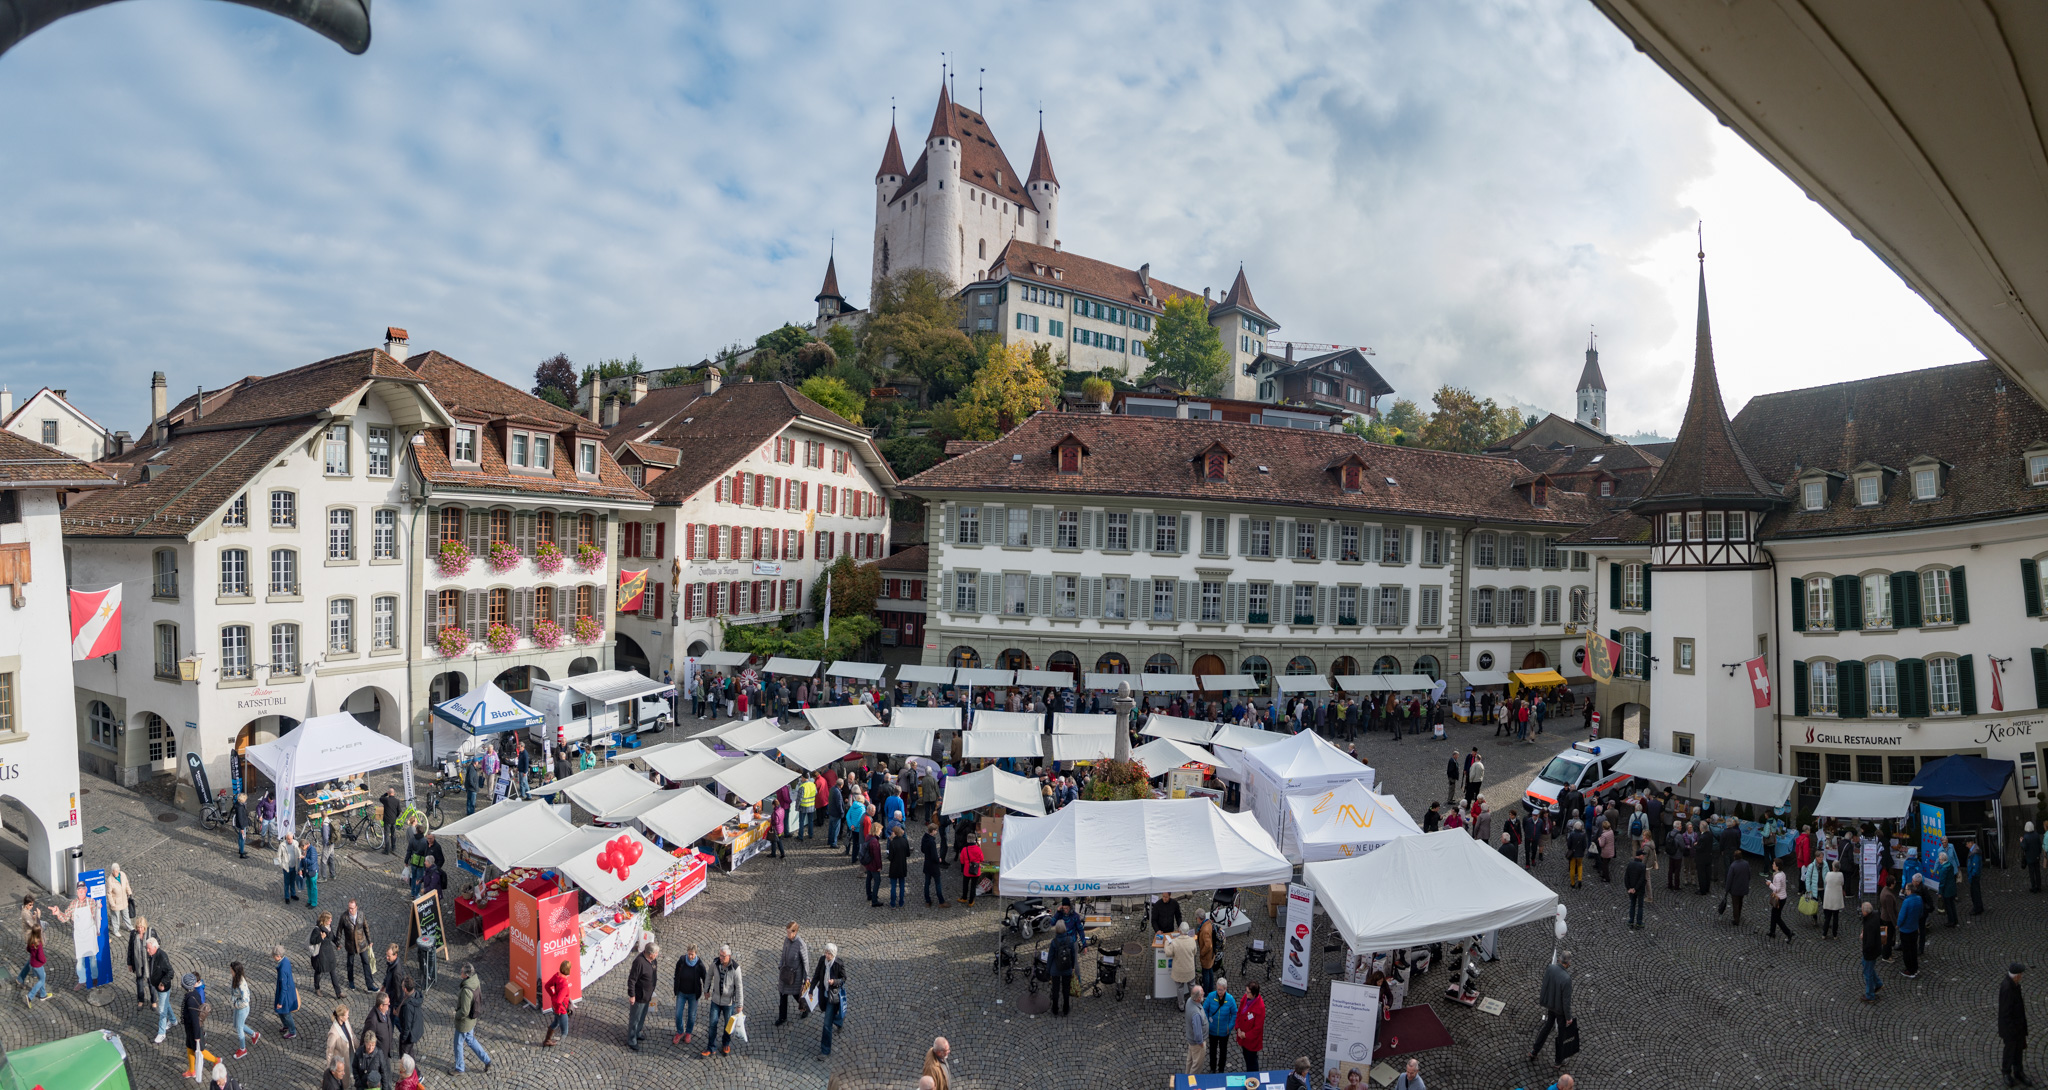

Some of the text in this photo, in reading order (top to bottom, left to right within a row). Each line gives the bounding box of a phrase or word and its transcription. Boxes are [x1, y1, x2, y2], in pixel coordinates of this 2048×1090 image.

[251, 688, 273, 697] Bistro
[237, 697, 287, 709] RATSSTÜBLI
[450, 702, 472, 717] BionX
[491, 708, 522, 719] BionX
[525, 717, 544, 726] BionX
[462, 722, 474, 734] BionX
[321, 741, 363, 754] FLYER
[379, 754, 408, 765] FLYER
[1922, 814, 1942, 829] UNI
[1923, 825, 1943, 838] SONO
[1044, 883, 1101, 892] MAX JUNG
[1290, 887, 1311, 898] kyBoot
[510, 926, 535, 949] SOLINA
[543, 934, 578, 952] SOLINA
[553, 948, 568, 957] SPIEZ
